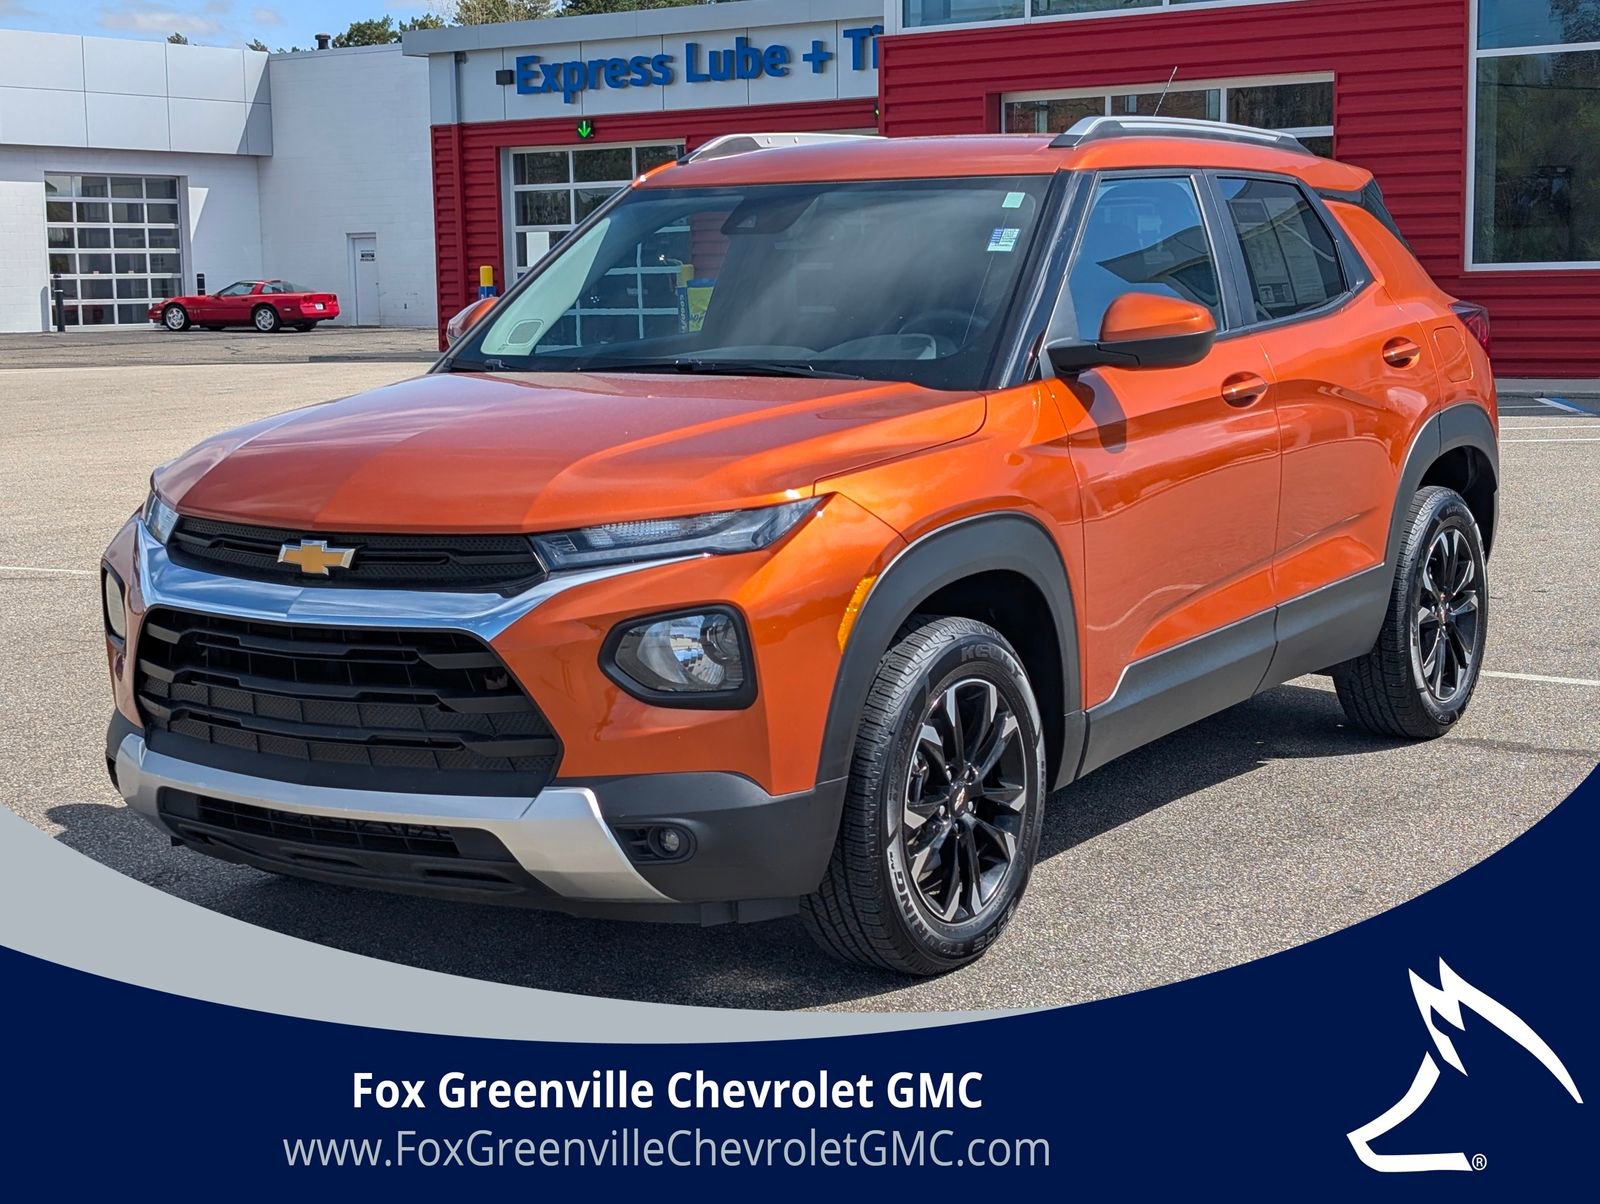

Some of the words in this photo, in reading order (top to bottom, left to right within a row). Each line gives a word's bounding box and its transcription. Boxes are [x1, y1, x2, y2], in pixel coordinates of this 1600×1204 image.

[516, 53, 674, 104] Express
[685, 36, 791, 84] Lube
[802, 40, 834, 74] +
[894, 870, 965, 956] TOURING
